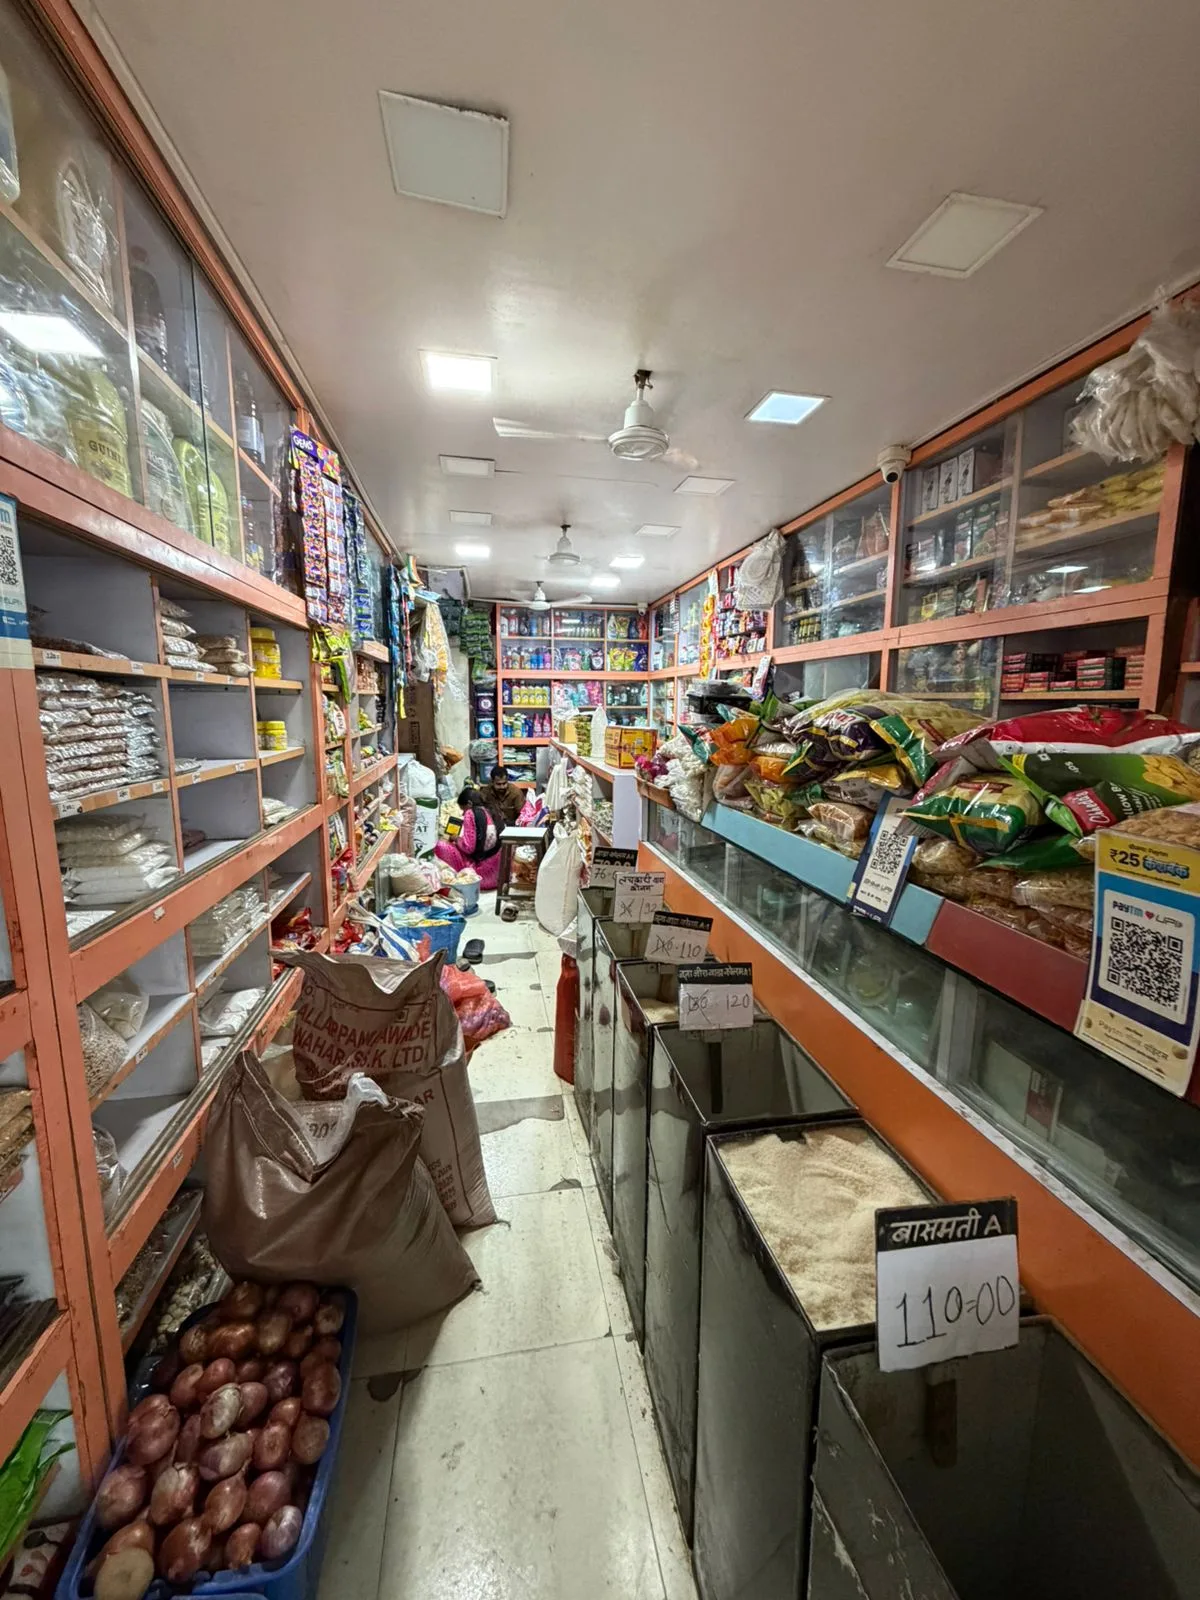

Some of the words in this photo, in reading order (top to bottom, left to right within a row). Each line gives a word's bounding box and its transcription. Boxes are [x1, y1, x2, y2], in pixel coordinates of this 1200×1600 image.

[292, 435, 314, 451] GEMS
[1109, 848, 1140, 868] ₹25
[726, 993, 751, 1011] 120
[889, 1207, 983, 1245] बासमती
[984, 1213, 1003, 1238] A
